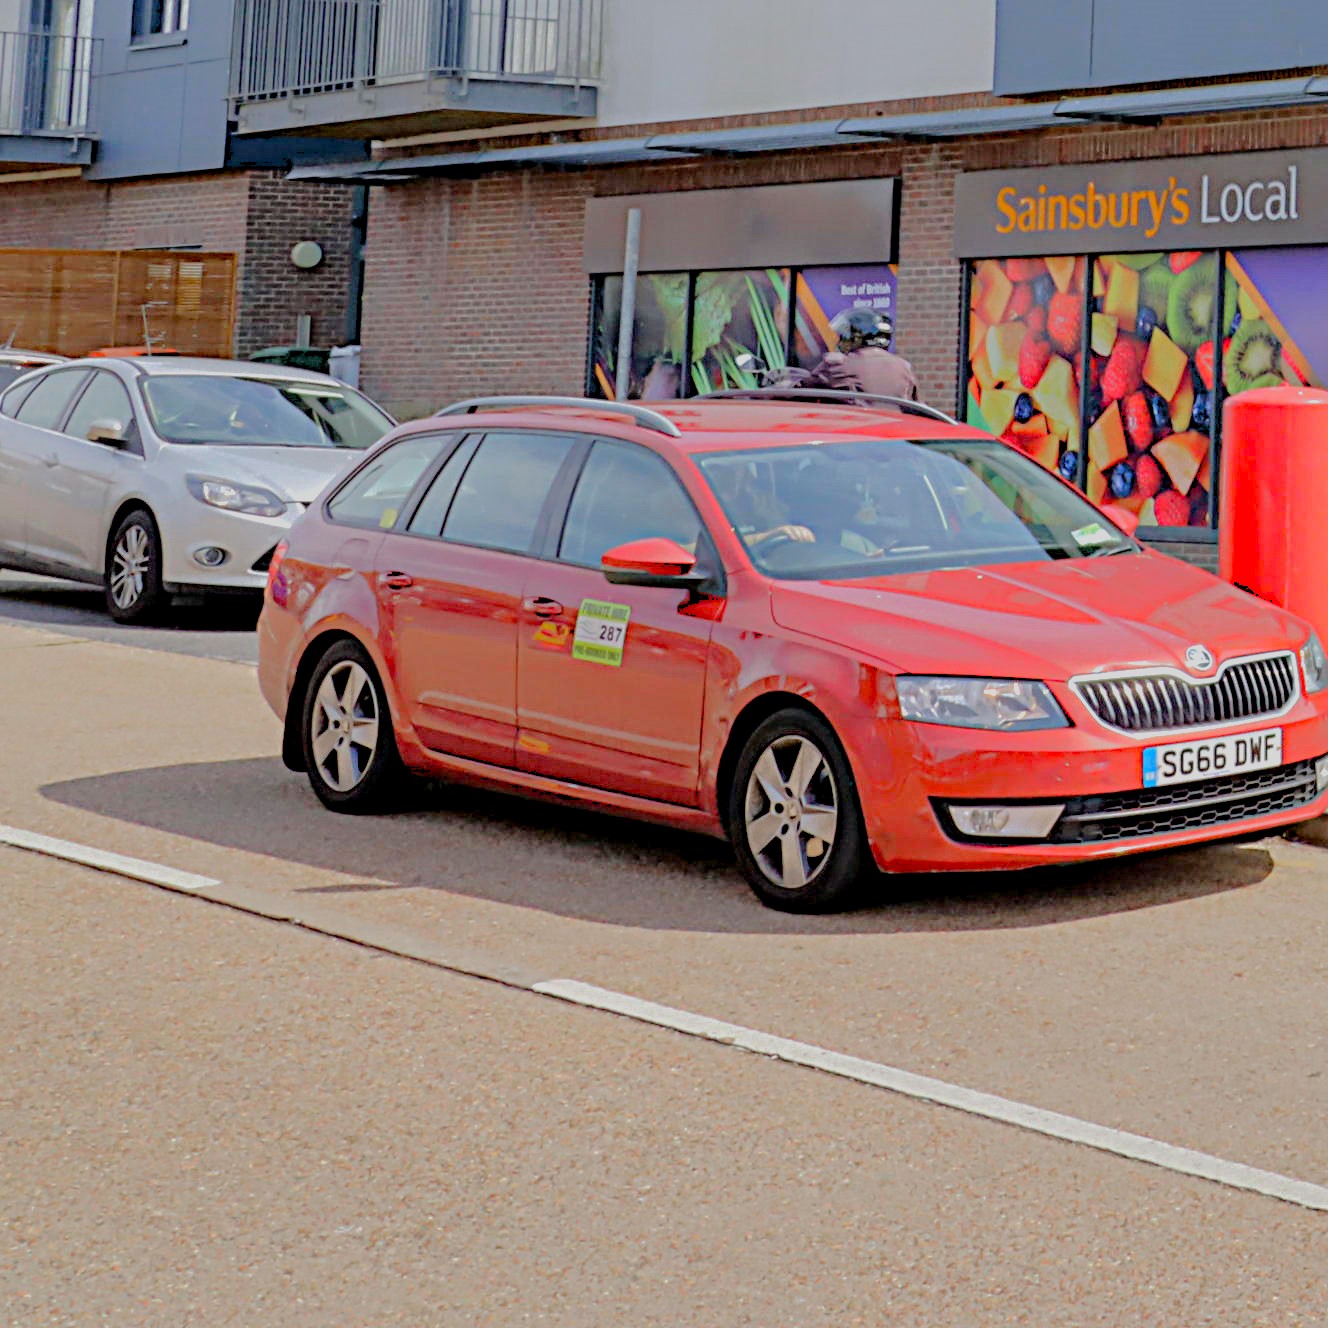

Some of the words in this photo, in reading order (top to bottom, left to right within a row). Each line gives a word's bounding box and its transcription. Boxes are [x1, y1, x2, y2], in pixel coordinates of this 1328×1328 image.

[995, 175, 1190, 238] Sainsbury's
[1200, 166, 1299, 224] Local
[841, 284, 857, 296] Best
[857, 283, 866, 295] of
[866, 282, 890, 295] British
[599, 624, 622, 642] 287
[1162, 742, 1227, 778] SG66
[1234, 733, 1276, 767] DWF
